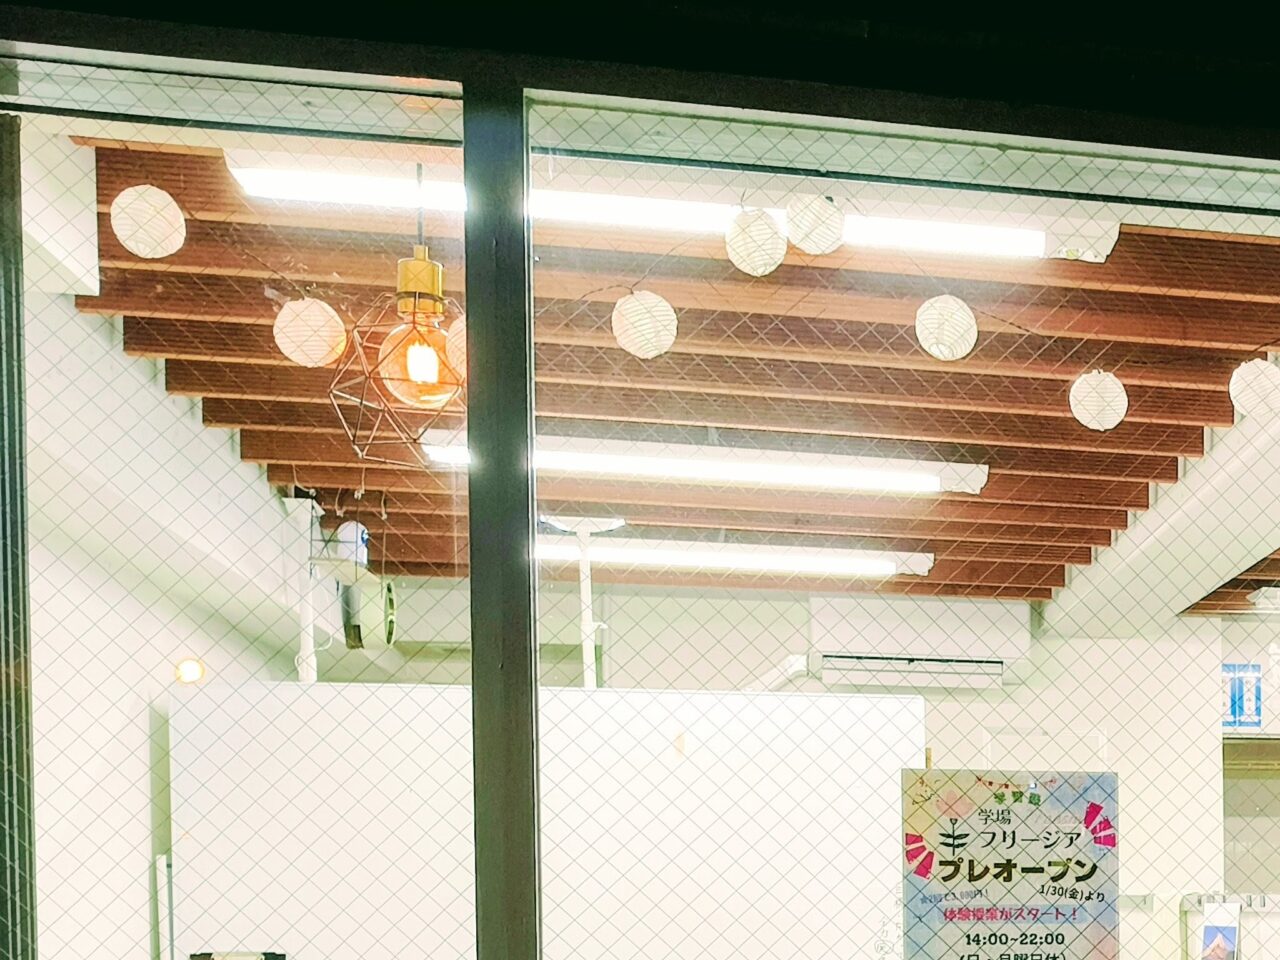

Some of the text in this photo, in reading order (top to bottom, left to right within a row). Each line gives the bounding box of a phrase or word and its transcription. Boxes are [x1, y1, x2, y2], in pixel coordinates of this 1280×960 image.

[978, 809, 1012, 825] 学場
[980, 830, 1082, 849] フリージア
[939, 857, 1098, 883] プレオープン
[1039, 884, 1106, 902] 1/30(金)より
